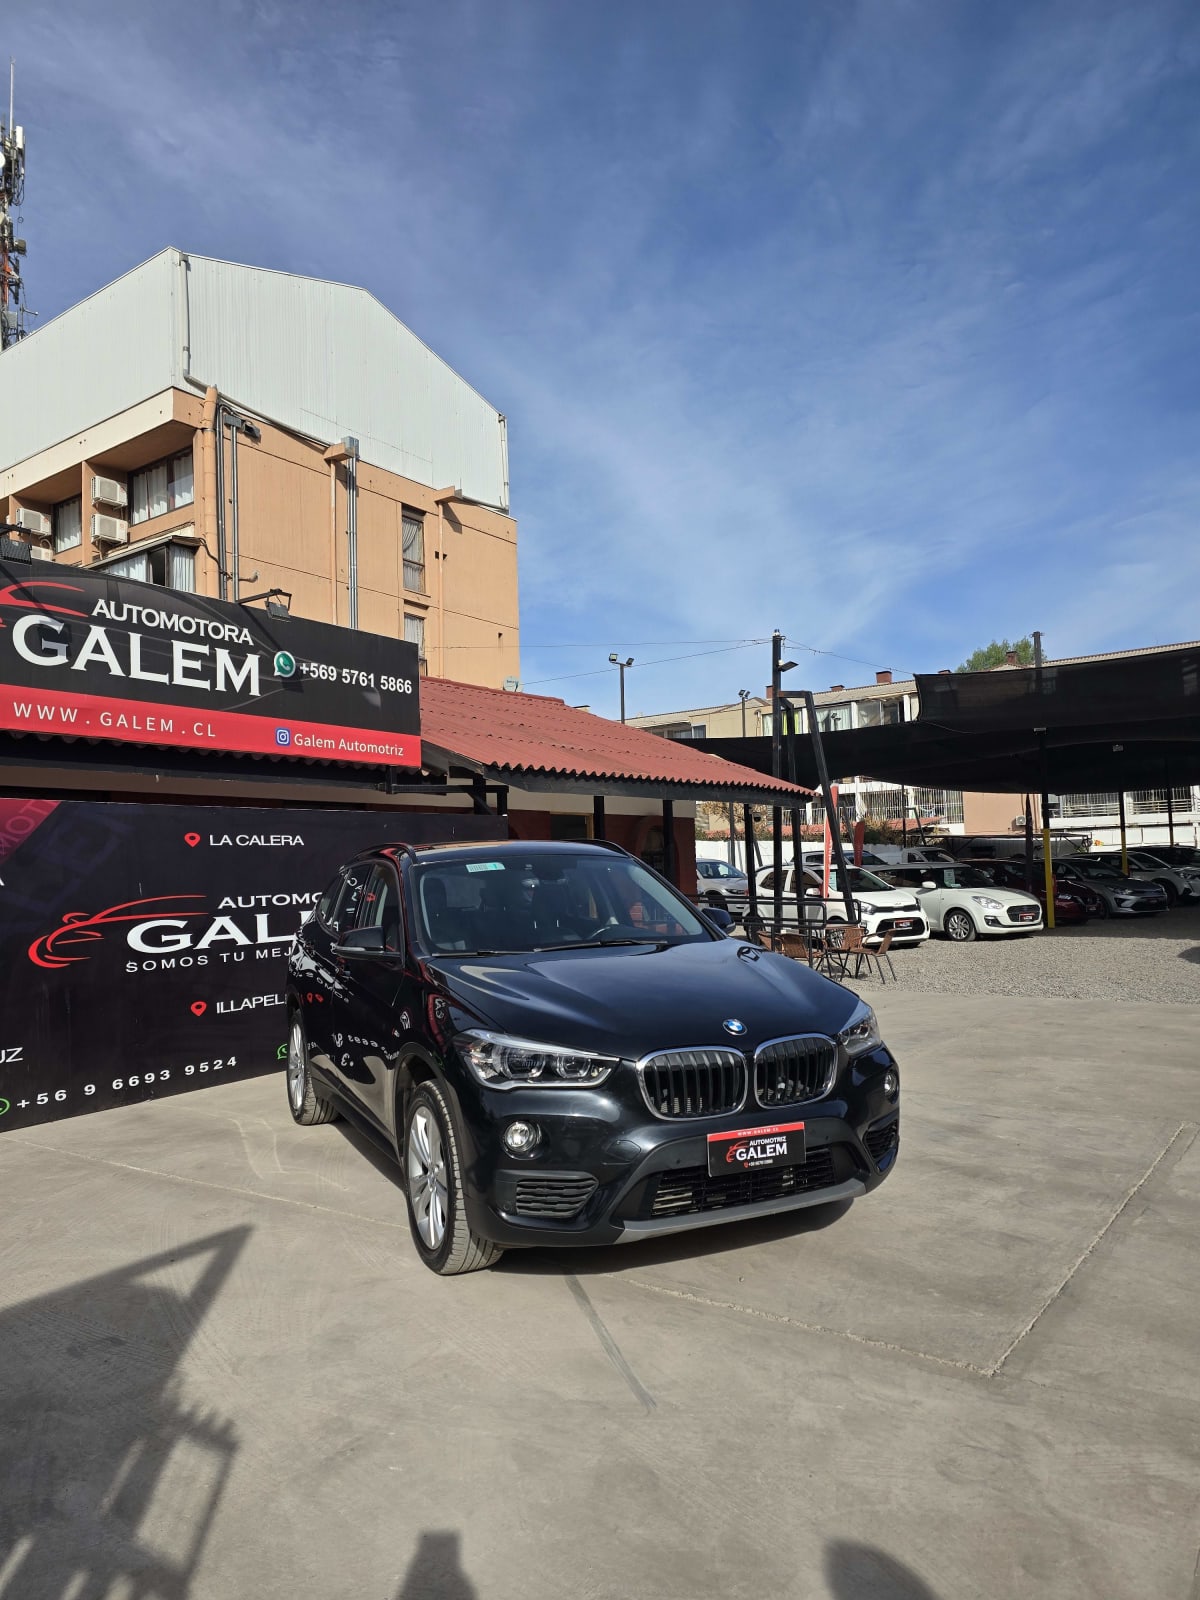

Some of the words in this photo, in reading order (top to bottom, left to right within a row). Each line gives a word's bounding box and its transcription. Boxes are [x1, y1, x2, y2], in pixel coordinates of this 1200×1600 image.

[92, 599, 254, 646] AUTOMOTORA
[12, 614, 261, 697] GALEM
[300, 662, 337, 682] +569
[341, 668, 375, 688] 5761
[380, 674, 413, 694] 5866
[294, 733, 335, 750] Galem
[338, 738, 404, 757] Automotriz
[209, 834, 233, 846] LA
[236, 834, 305, 847] CALERA
[125, 955, 209, 973] SOMOS
[219, 951, 245, 963] TU
[216, 993, 287, 1014] ILLAPEL
[16, 1089, 67, 1109] +56
[83, 1084, 96, 1096] 9
[112, 1069, 171, 1090] 6693
[184, 1056, 238, 1076] 9524
[735, 1142, 788, 1161] GALEM
[749, 1135, 787, 1147] AUTOMOTRIZ
